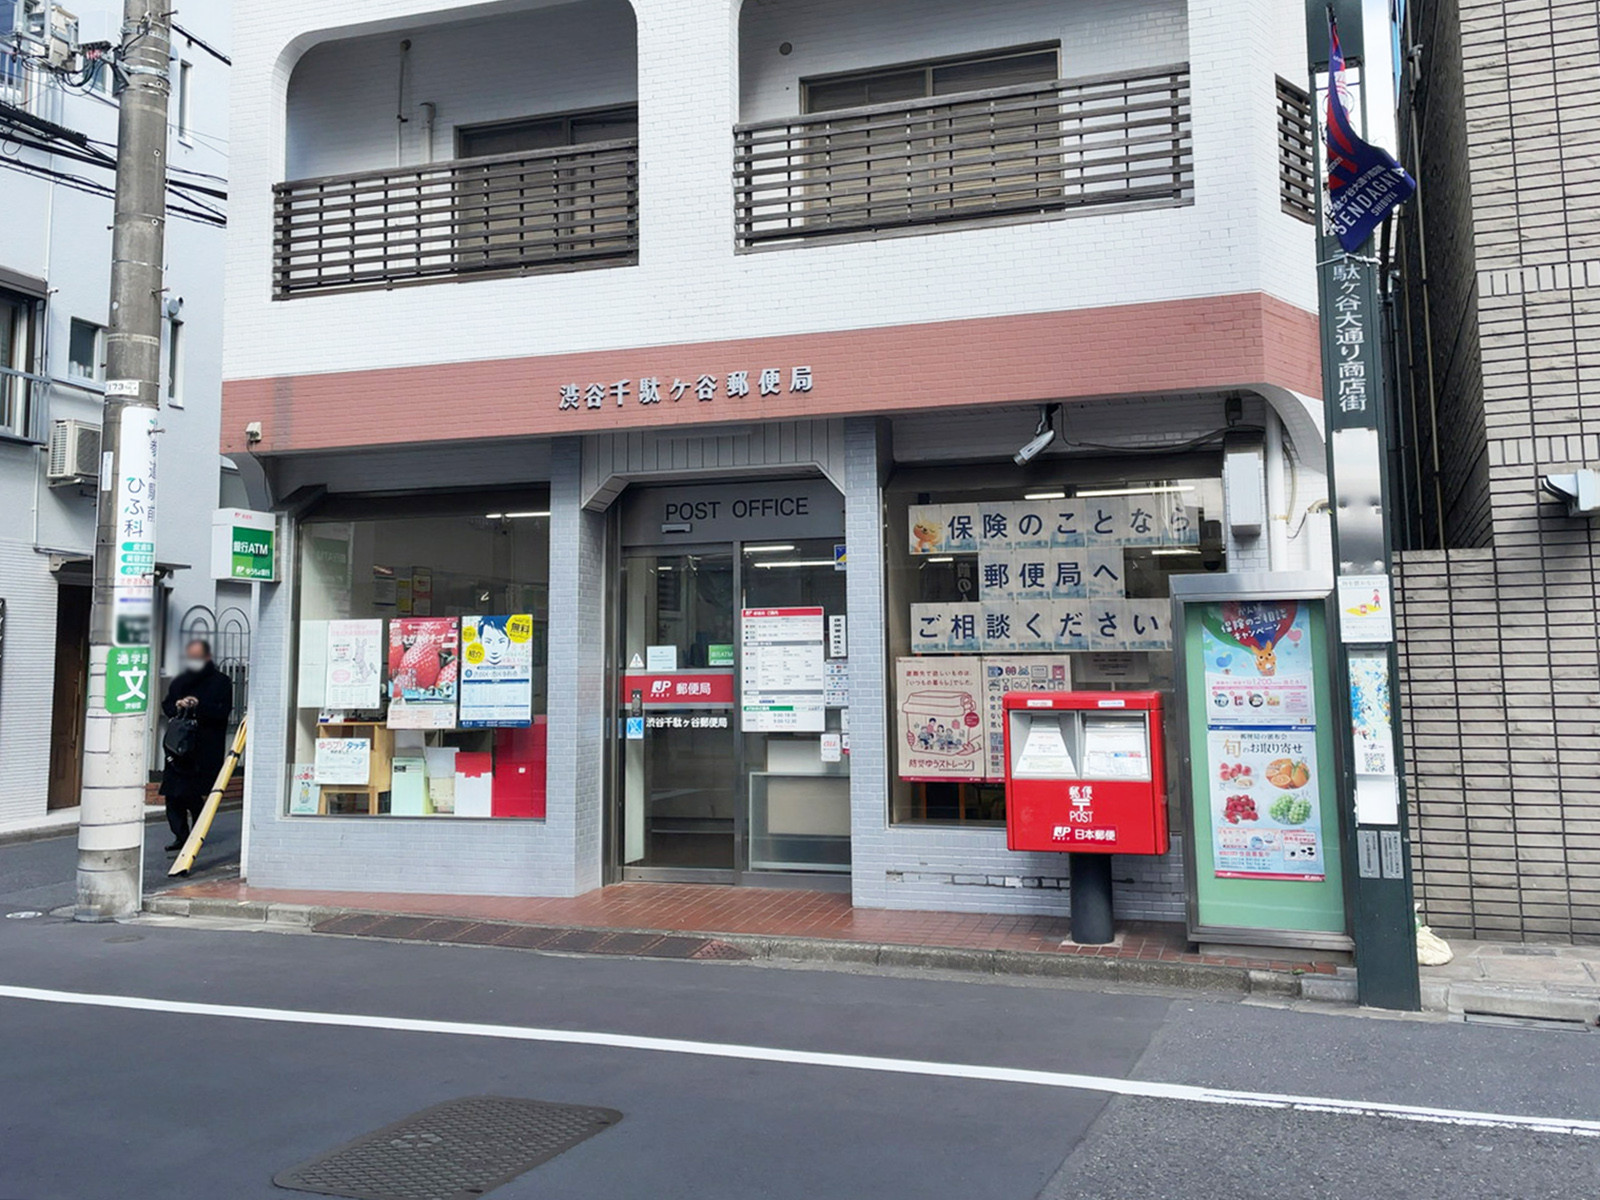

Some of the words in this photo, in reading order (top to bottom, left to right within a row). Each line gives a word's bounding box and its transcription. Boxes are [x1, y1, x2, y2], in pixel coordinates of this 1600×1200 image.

[1334, 167, 1405, 236] SENDAGAYA
[124, 477, 145, 538] ひふ科
[666, 501, 720, 521] POST
[732, 497, 809, 519] OFFICE
[948, 507, 1190, 540] 保険のことなら
[233, 541, 268, 555] 銀行ATM
[984, 562, 1119, 589] 郵便局へ
[919, 611, 1159, 640] ご相談ください
[1234, 624, 1281, 640] キャンペーン
[117, 666, 147, 702] 文
[676, 682, 711, 695] 郵便局
[1223, 739, 1303, 758] 旬のお取り寄せ
[1069, 786, 1093, 800] 郵便
[1069, 810, 1093, 822] POST
[1075, 829, 1116, 841] 日本郵便
